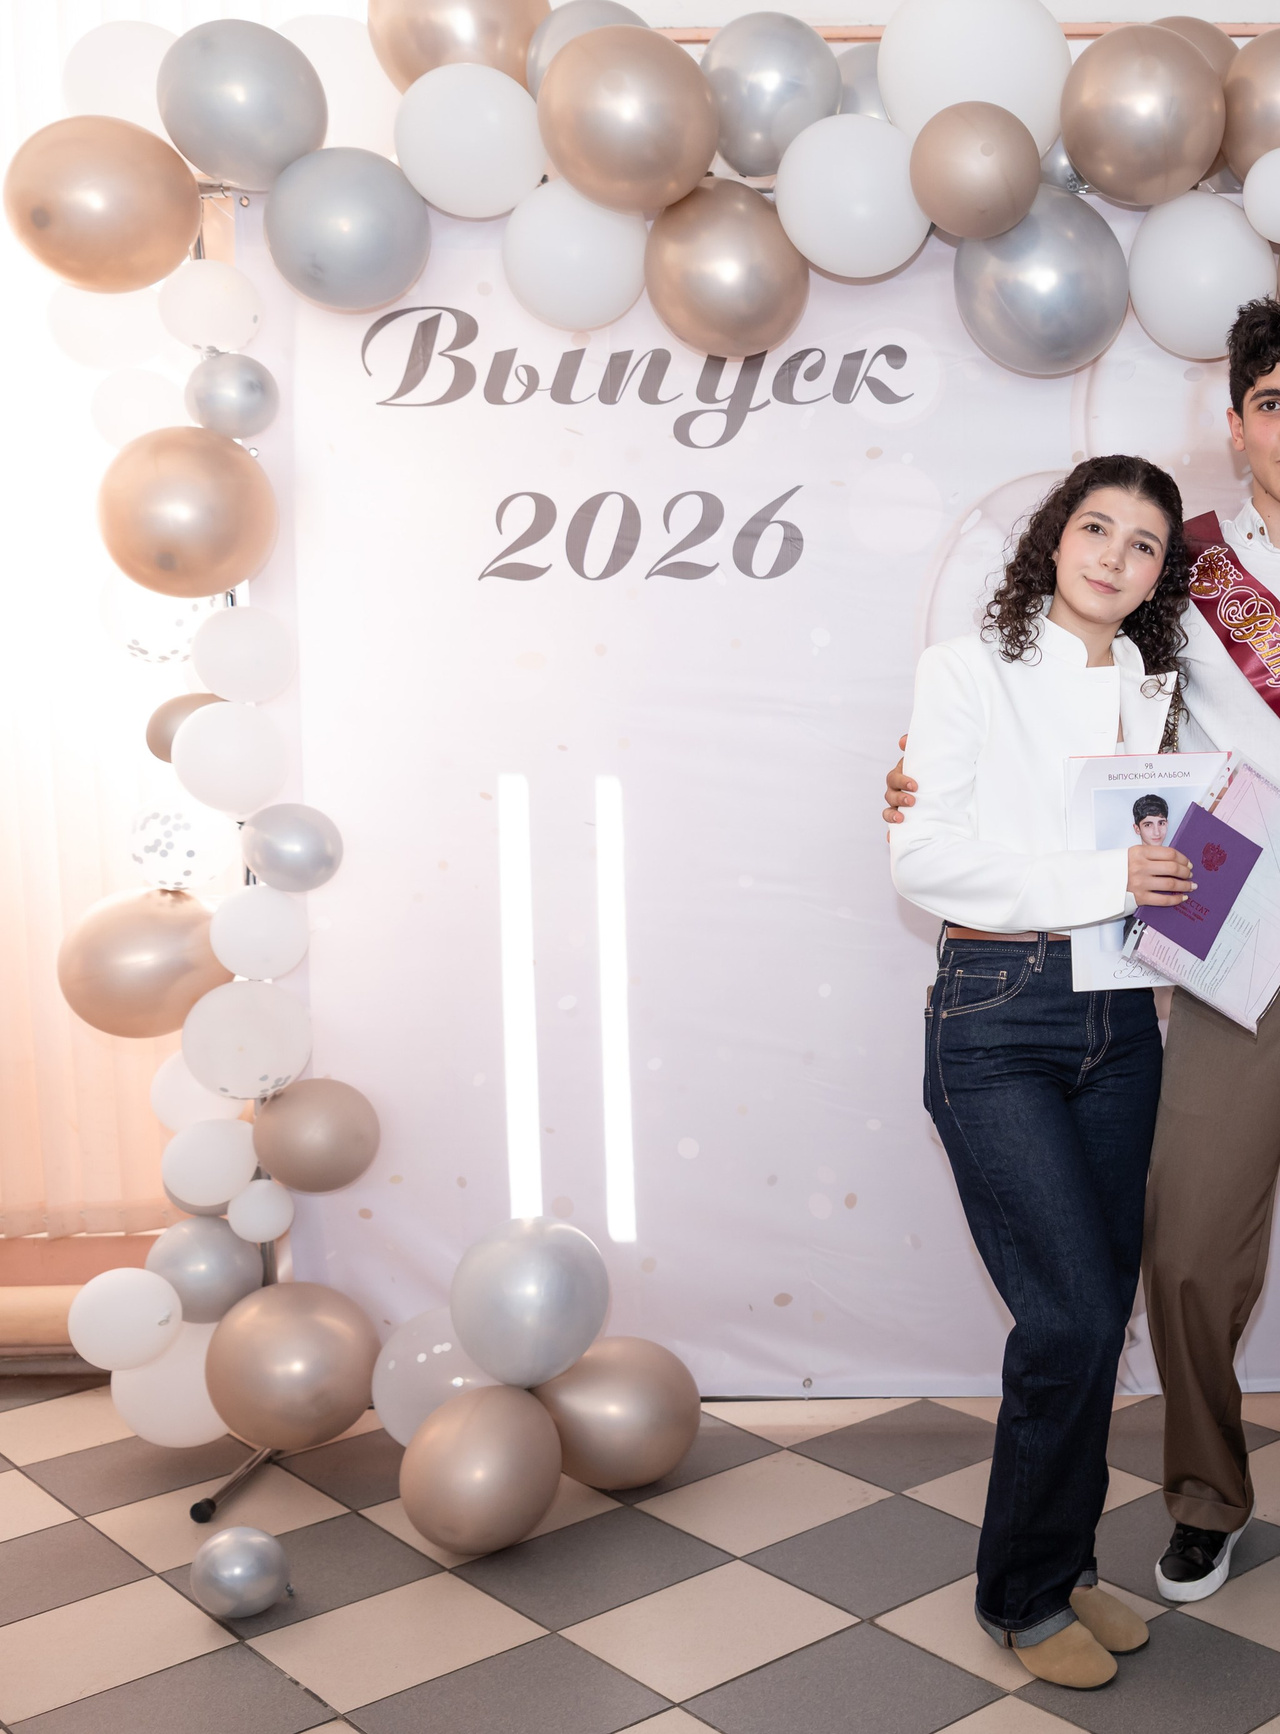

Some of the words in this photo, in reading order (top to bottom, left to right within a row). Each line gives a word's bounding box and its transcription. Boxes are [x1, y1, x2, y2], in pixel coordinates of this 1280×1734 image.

[361, 306, 915, 449] Выпуск
[477, 485, 805, 582] 2026
[1107, 771, 1156, 781] ВЫПУСКНОЙ
[1157, 771, 1191, 779] АЛЬБОМ
